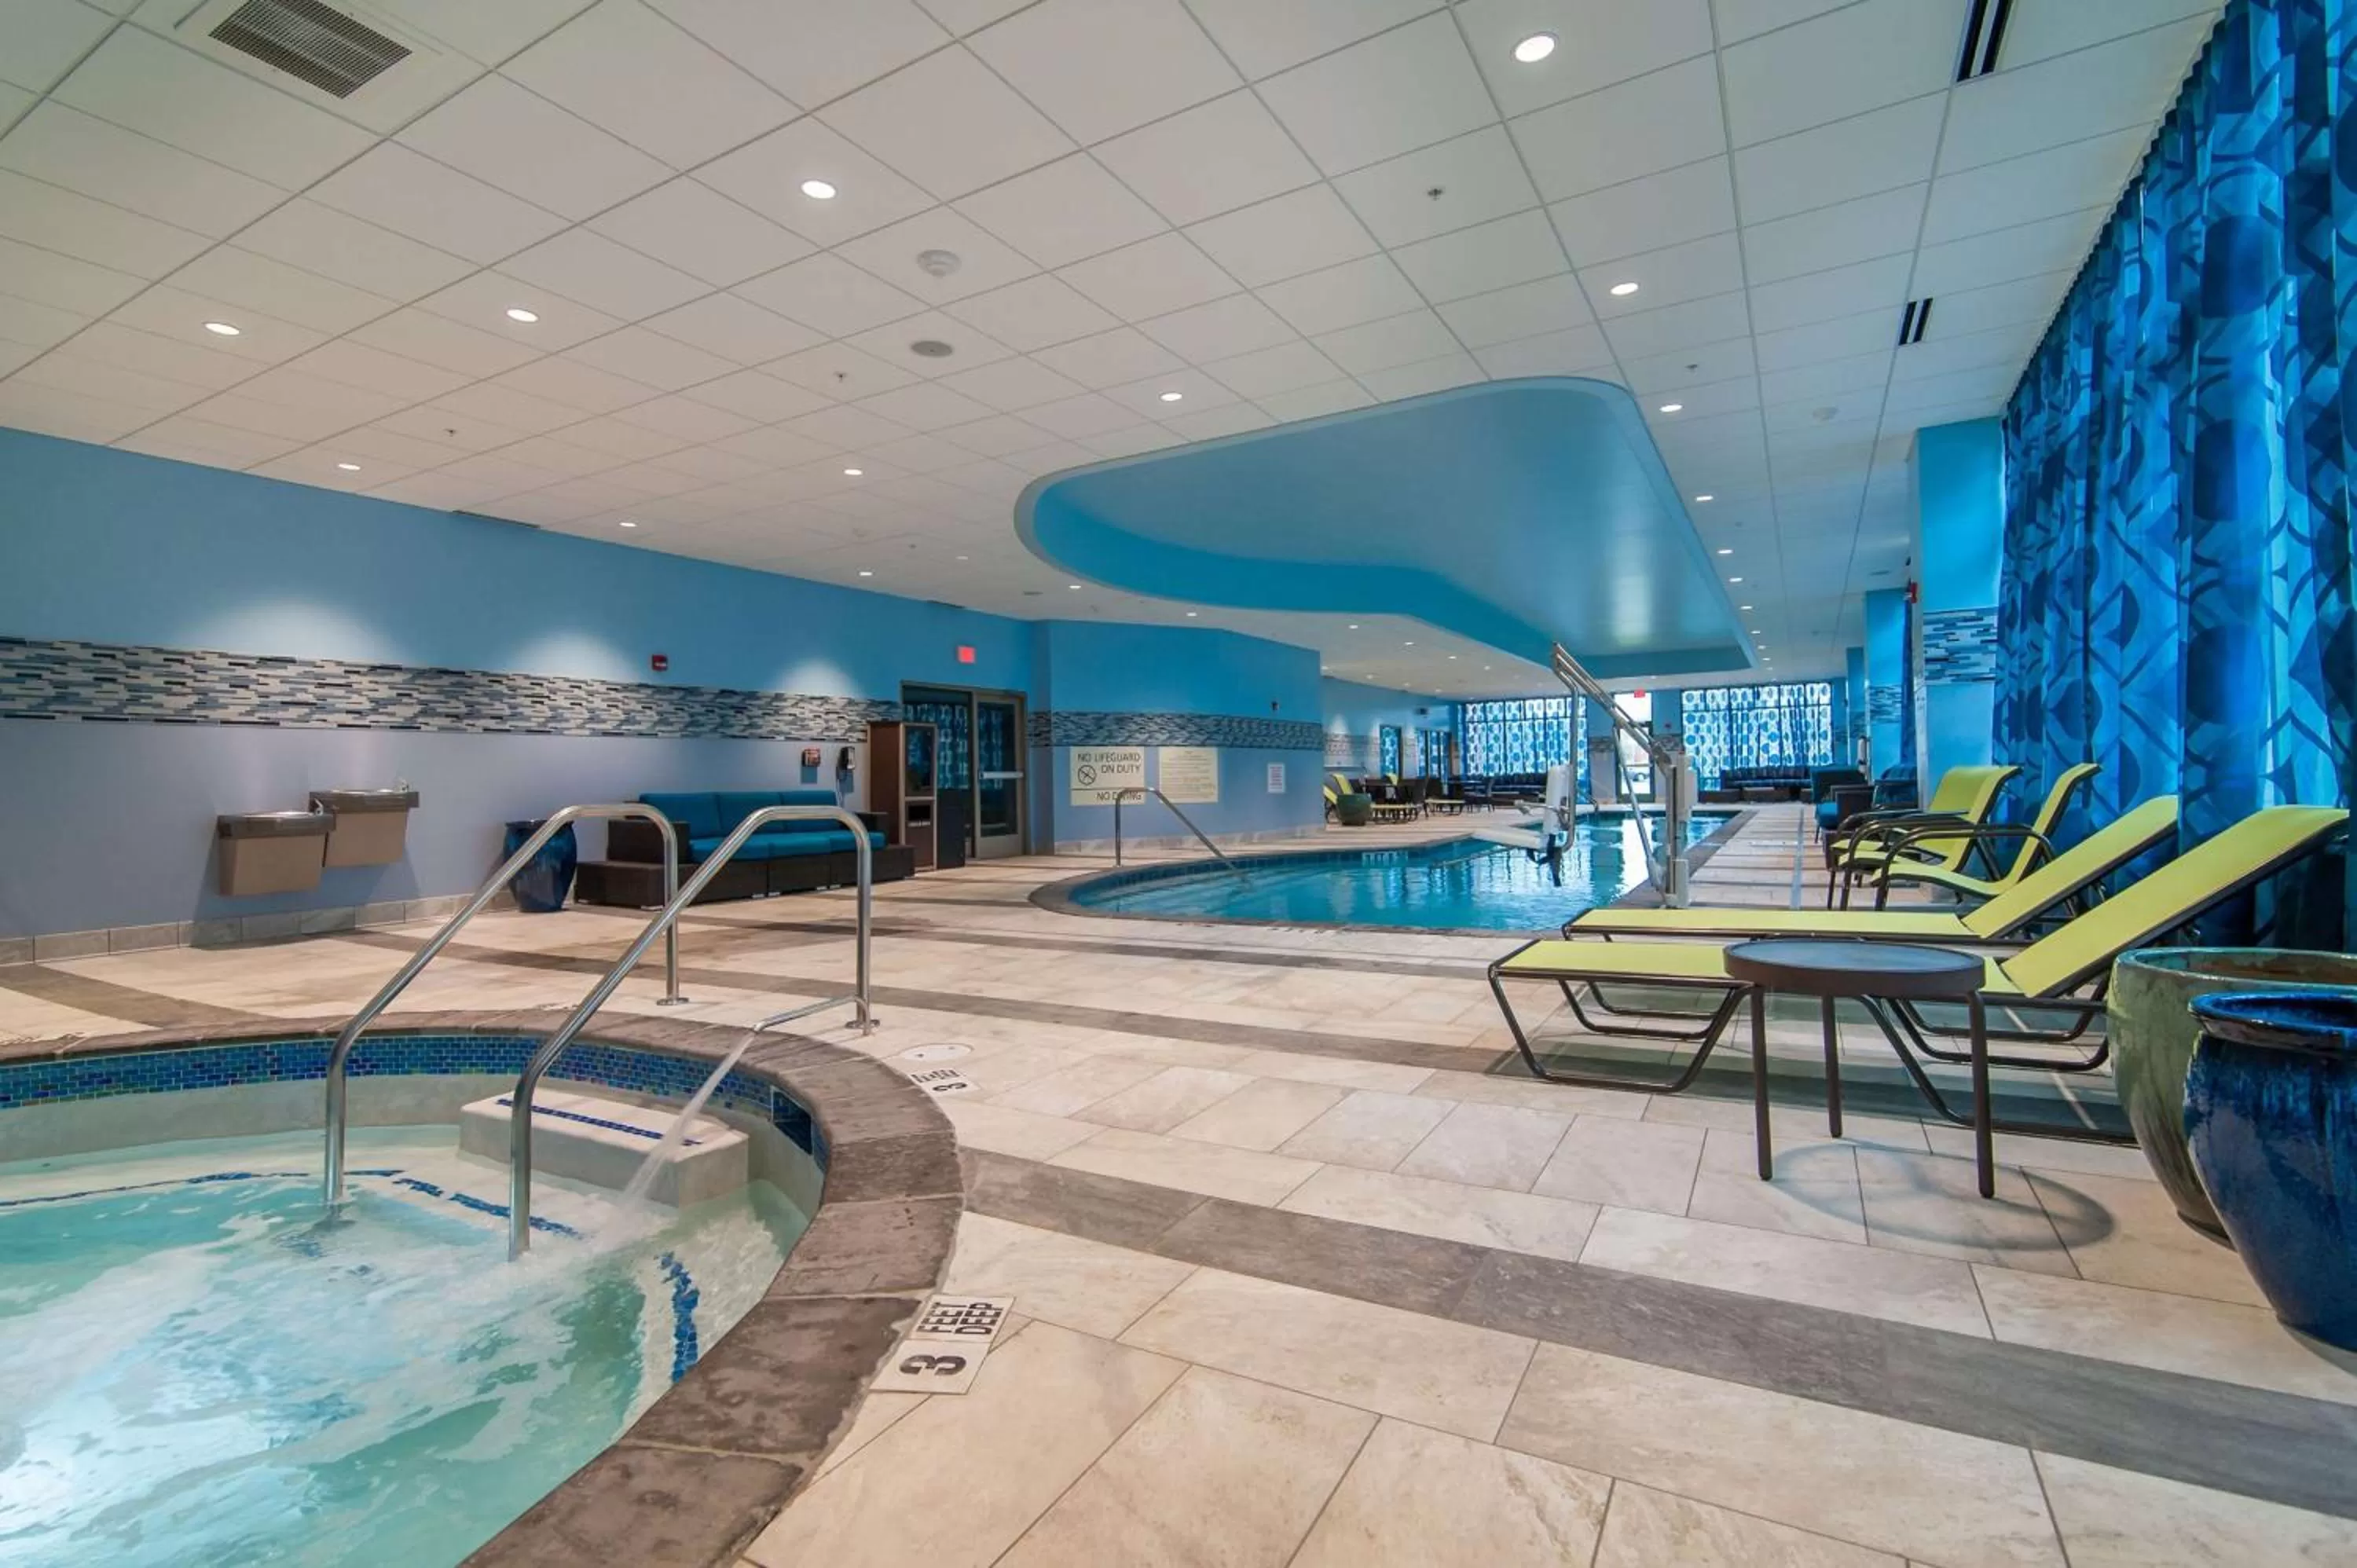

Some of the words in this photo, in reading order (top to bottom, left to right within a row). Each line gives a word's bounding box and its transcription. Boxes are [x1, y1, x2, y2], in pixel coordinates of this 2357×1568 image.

[1077, 753, 1091, 762] NO
[1094, 752, 1142, 763] LIFEGUARD
[1101, 764, 1115, 774] ON
[1116, 764, 1142, 774] DUTY
[1096, 791, 1110, 801] NO
[1112, 791, 1142, 800] DVING
[915, 1301, 968, 1333] FEET
[953, 1301, 1005, 1335] DEEP
[899, 1354, 967, 1376] 3
